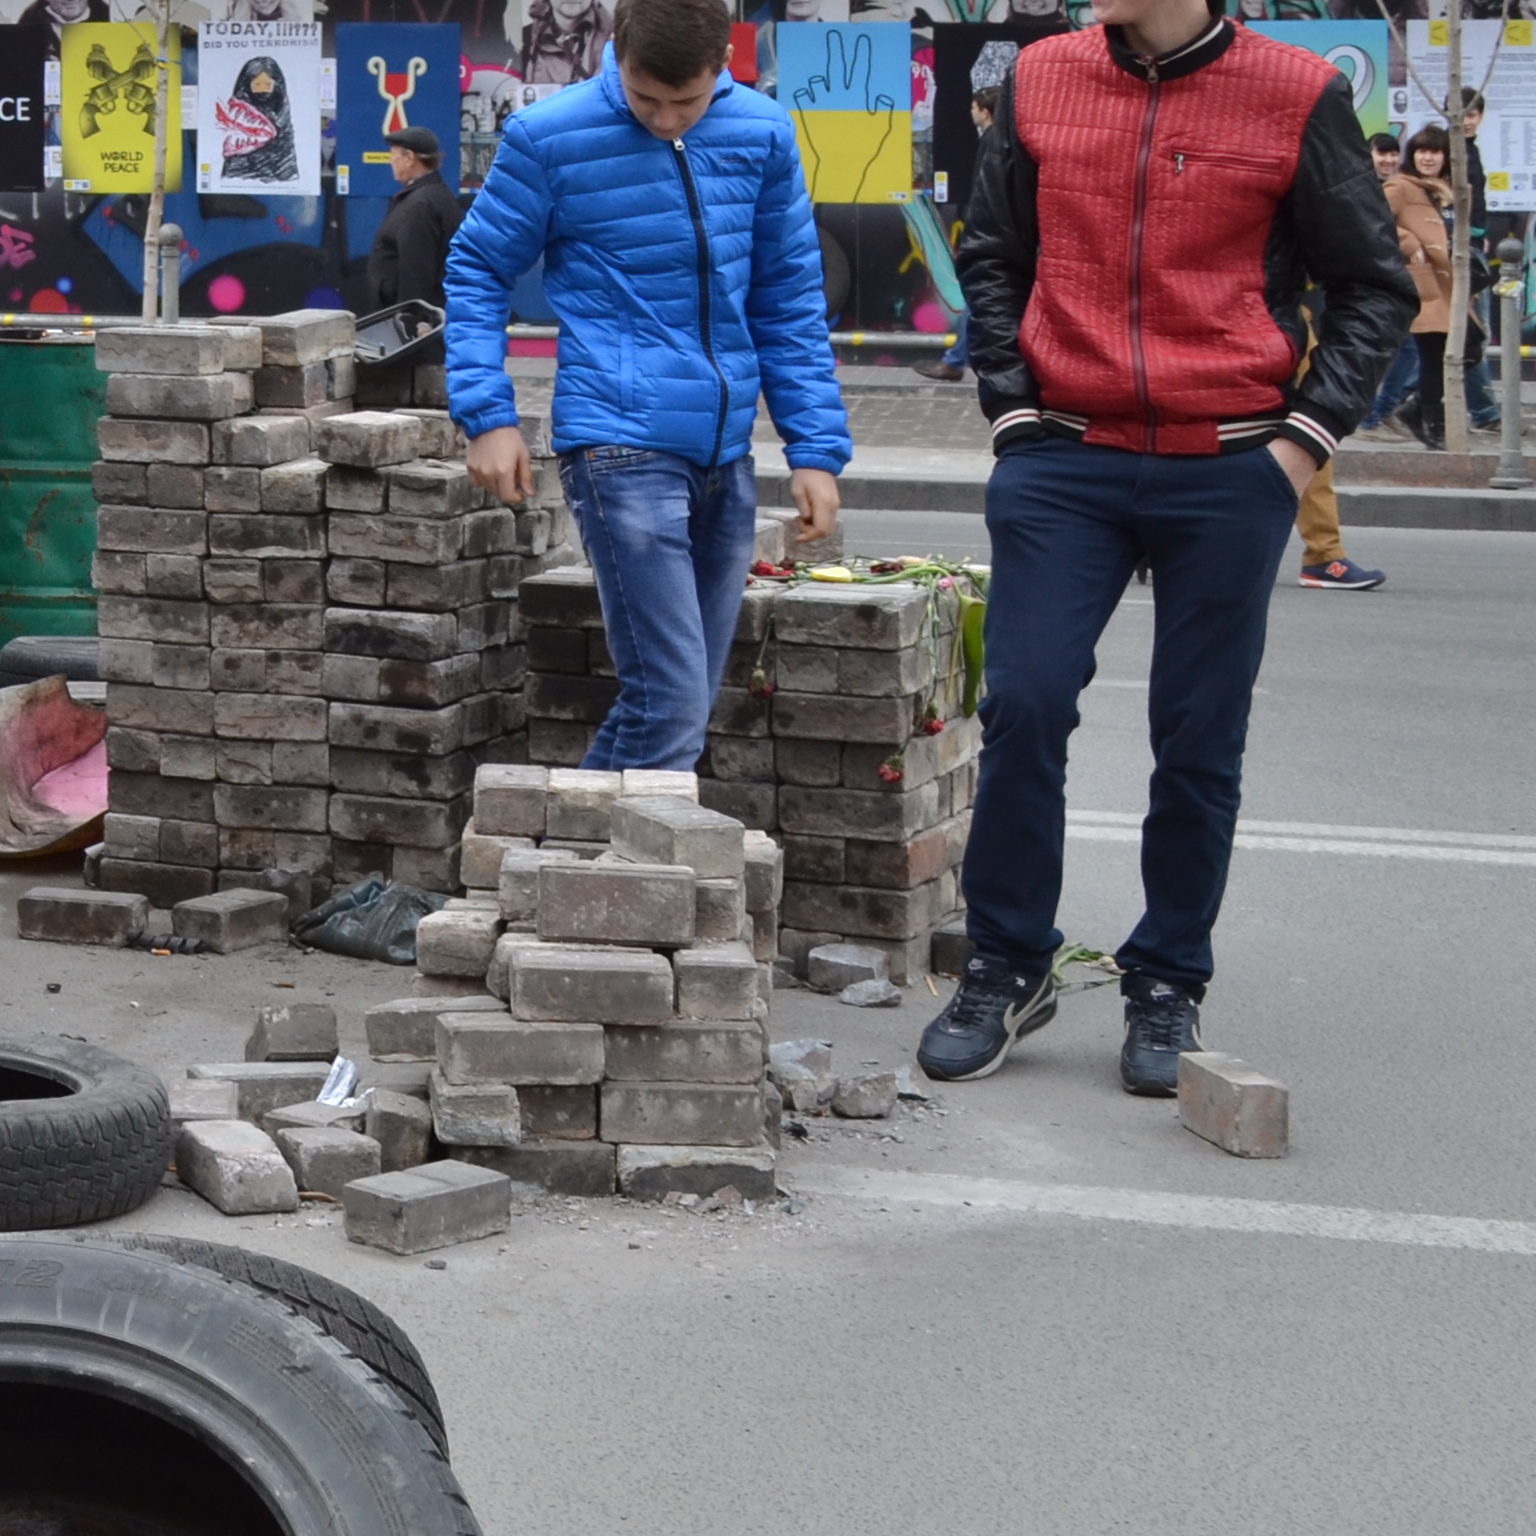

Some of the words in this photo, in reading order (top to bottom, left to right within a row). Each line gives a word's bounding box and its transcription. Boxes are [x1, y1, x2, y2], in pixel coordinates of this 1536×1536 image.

[226, 40, 249, 49] YOU
[100, 150, 144, 162] WORLD
[103, 162, 140, 174] PEACE
